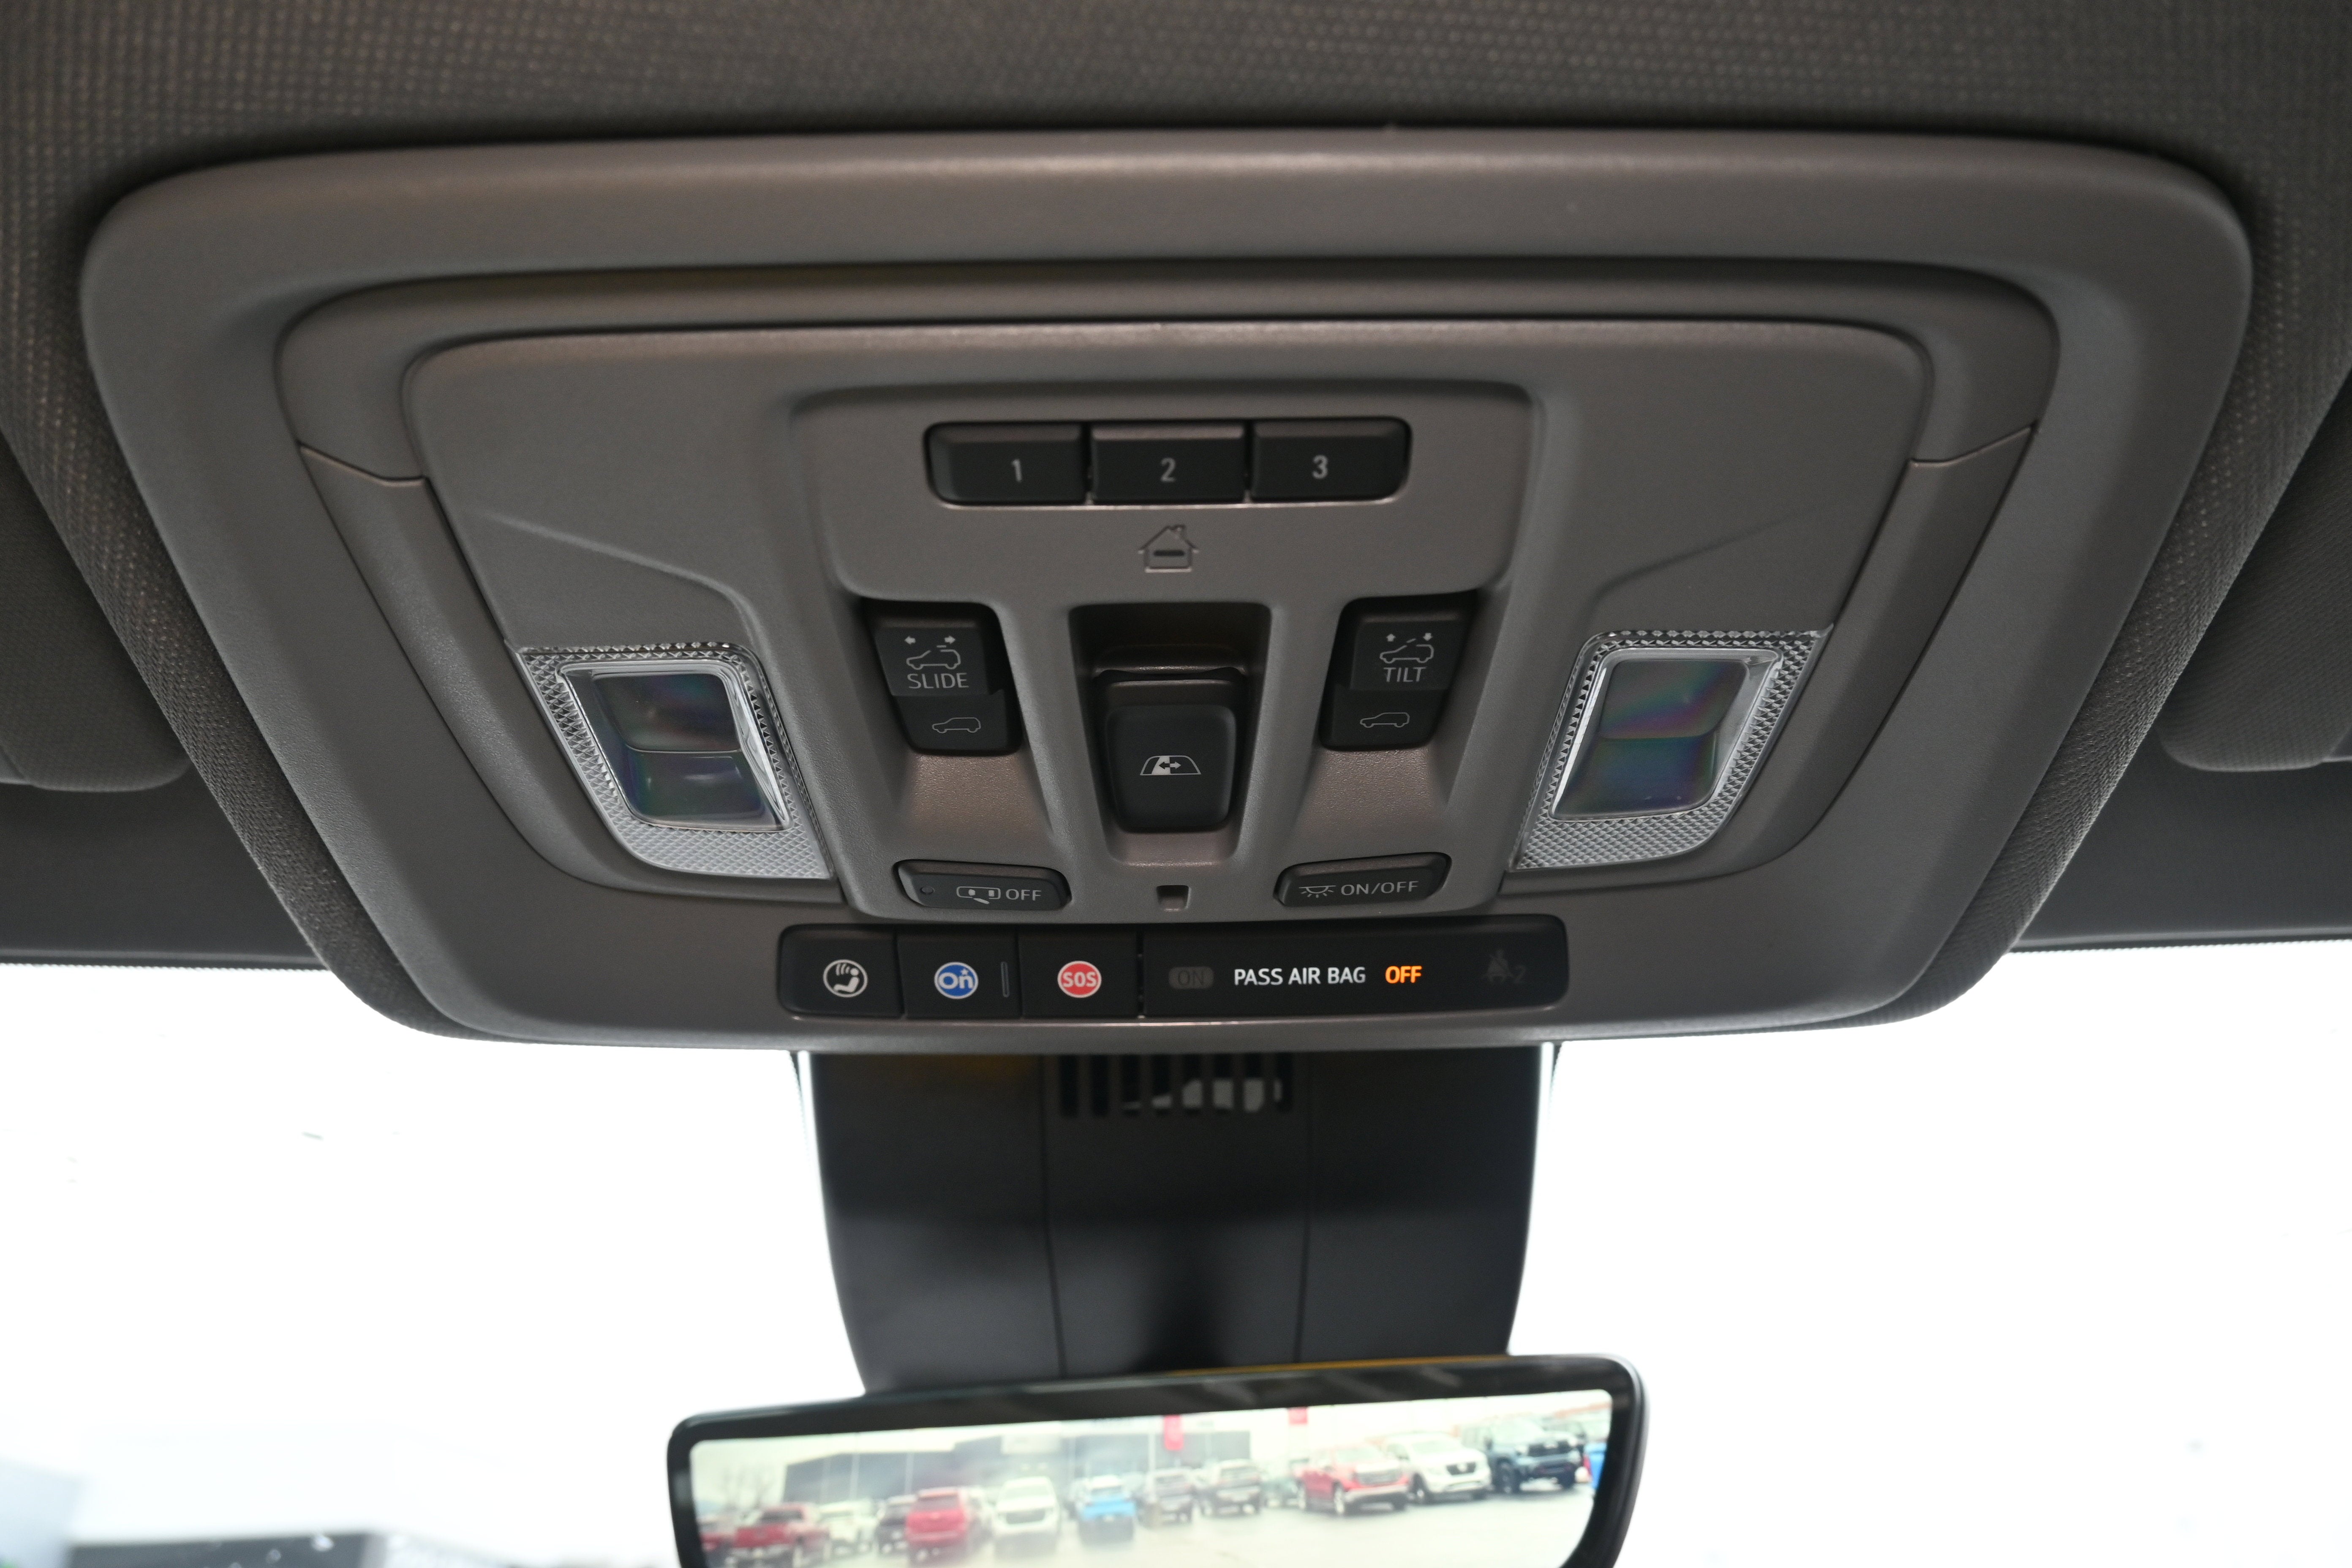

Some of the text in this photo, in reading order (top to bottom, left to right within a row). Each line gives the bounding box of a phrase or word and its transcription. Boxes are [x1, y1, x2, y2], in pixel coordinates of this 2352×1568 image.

[1012, 459, 1022, 482] 1
[1161, 457, 1176, 482] 2
[1313, 455, 1328, 479] 3
[907, 672, 969, 689] SLIDE
[1383, 667, 1426, 683] TILT
[1005, 888, 1042, 901] OFF
[1341, 880, 1418, 896] ON/OFF
[938, 972, 974, 989] On
[1062, 972, 1097, 988] SOS
[1178, 965, 1422, 986] ON PASS AIR BAG OFF
